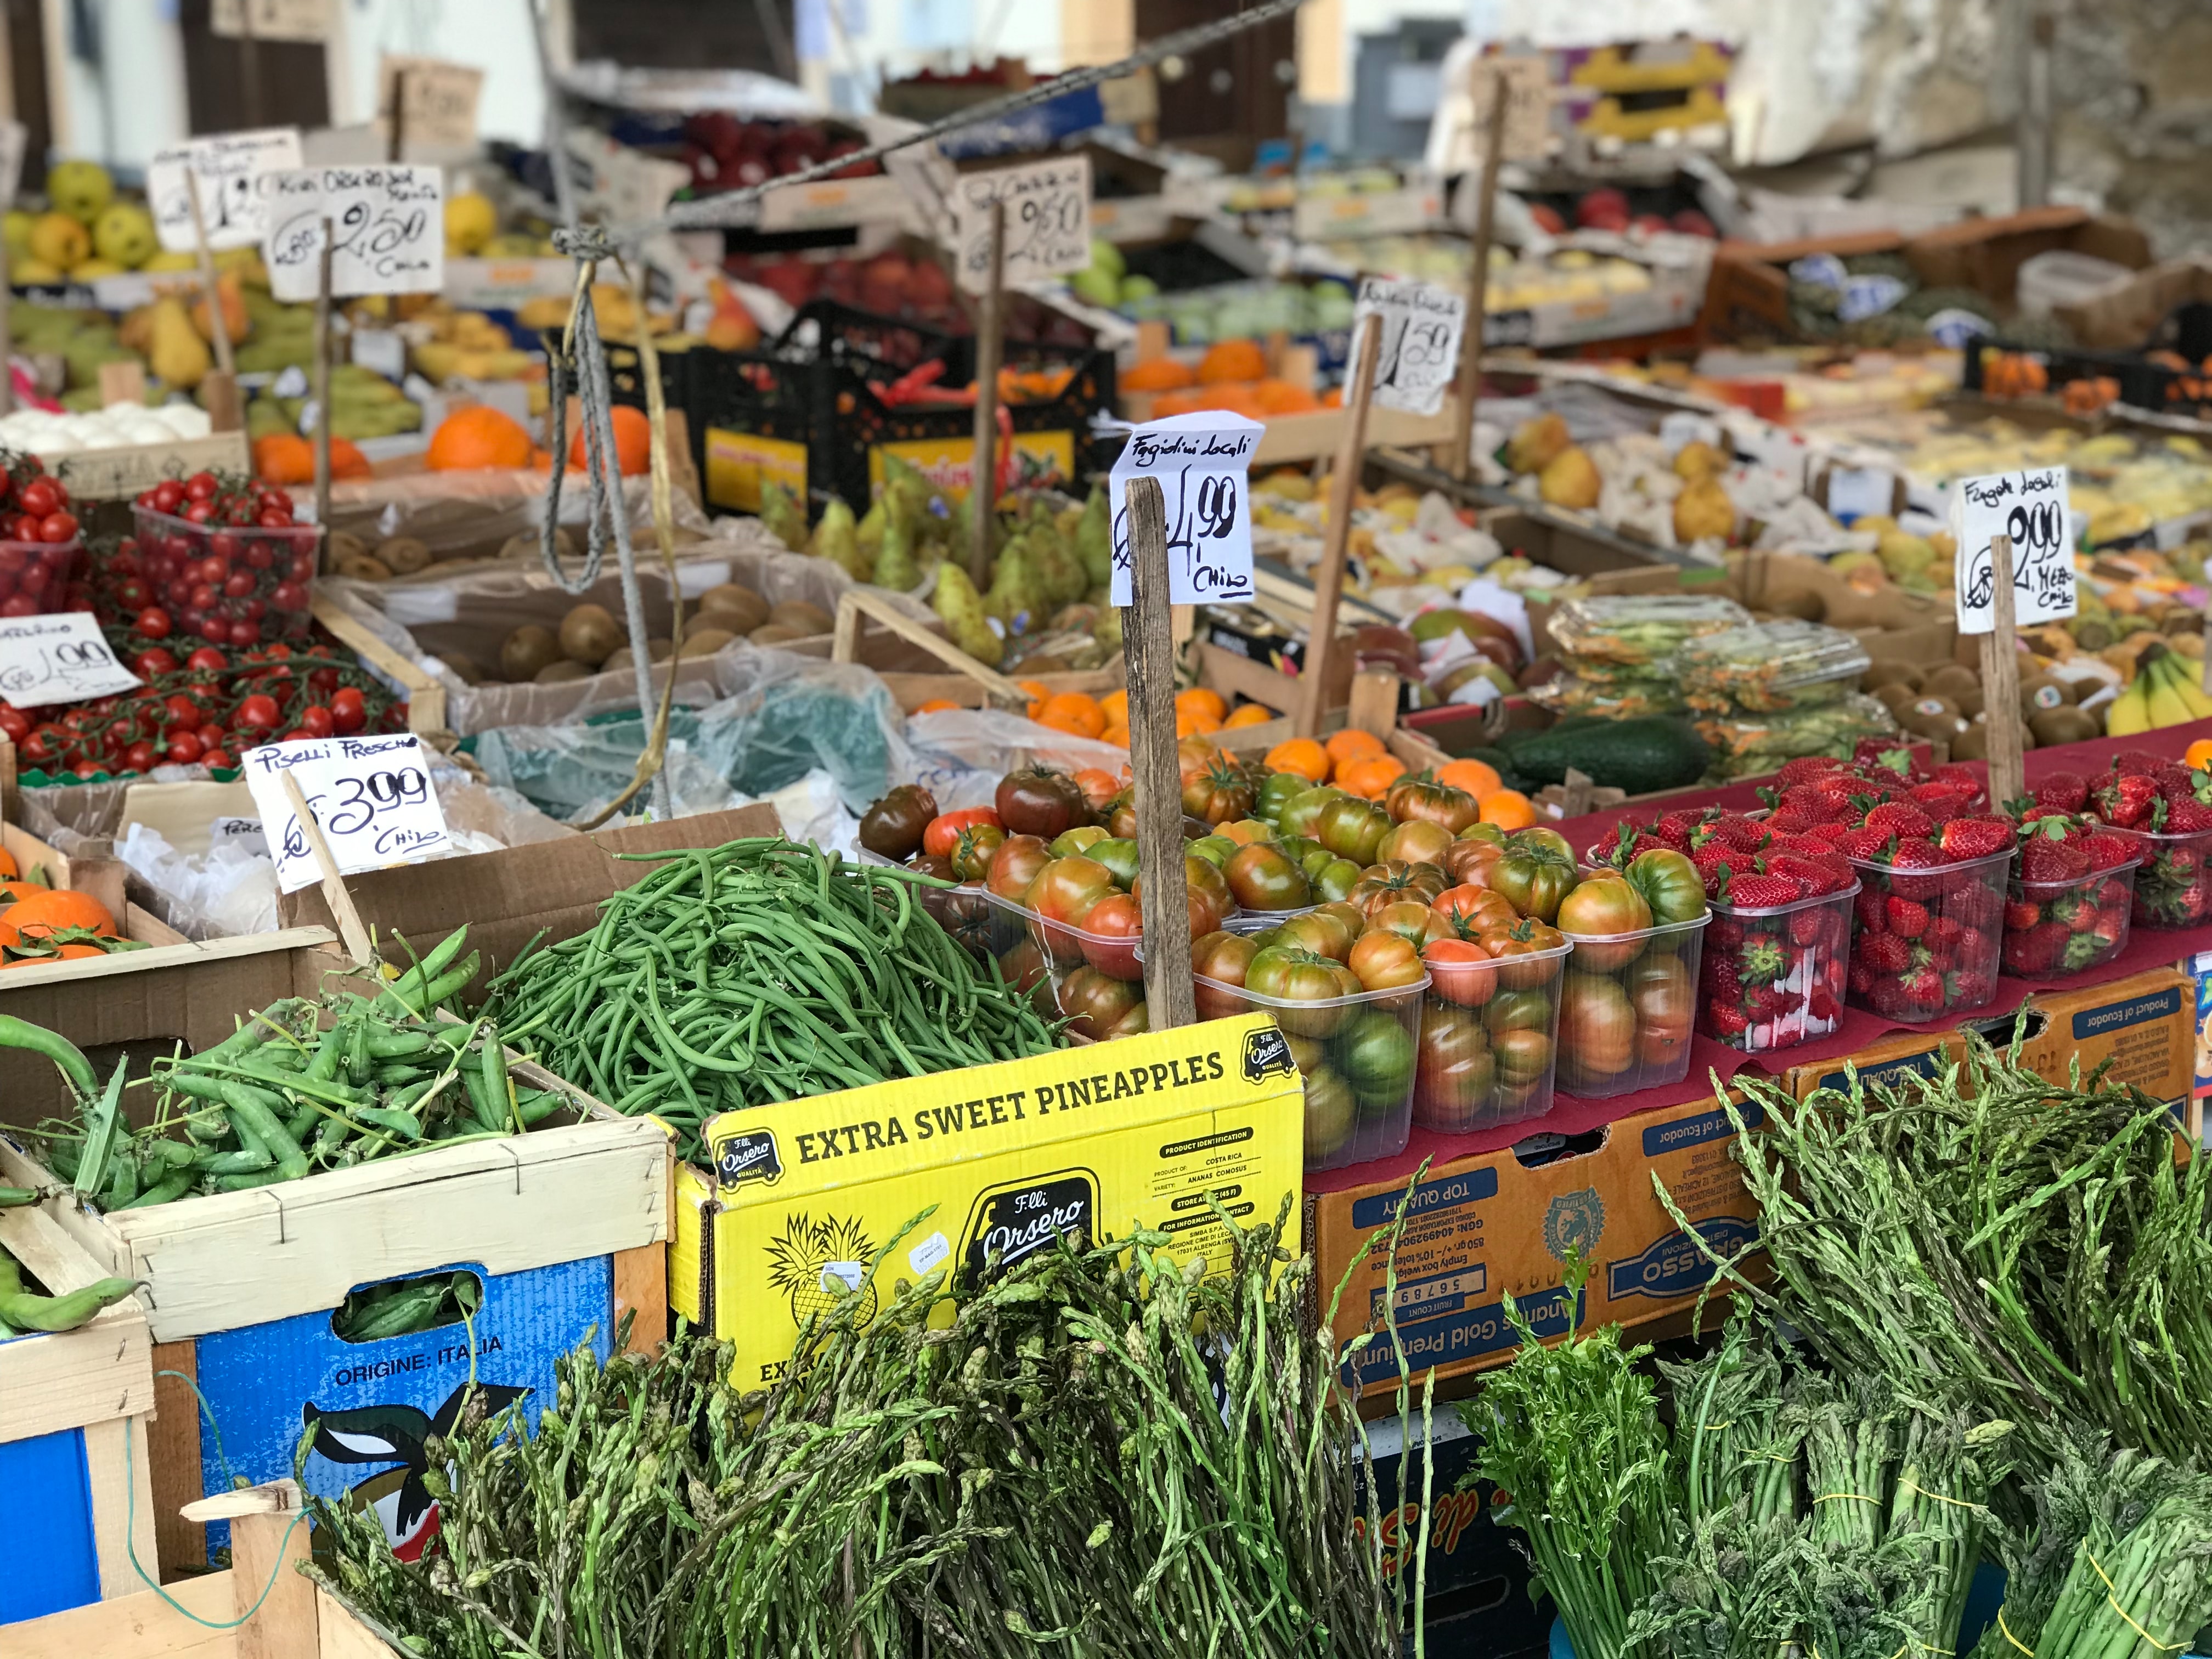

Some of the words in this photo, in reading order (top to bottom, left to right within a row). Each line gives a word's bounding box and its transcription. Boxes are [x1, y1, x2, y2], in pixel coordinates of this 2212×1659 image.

[2125, 1007, 2134, 1020] of
[2136, 997, 2168, 1017] Product
[2087, 1011, 2123, 1028] Ecuador
[1251, 1040, 1283, 1064] Orsero
[795, 1116, 909, 1164] EXTRA
[915, 1091, 1026, 1141] SWEET
[1035, 1052, 1224, 1115] PINEAPPLES
[1659, 1124, 1700, 1143] Ecuador
[1702, 1121, 1713, 1135] of
[1165, 1143, 1197, 1155] PRODUCT
[1197, 1131, 1248, 1148] IDENTIFICATION
[722, 1142, 770, 1172] Orsero
[1154, 1168, 1178, 1177] PRODUCT
[1206, 1156, 1226, 1165] COSTA
[1228, 1152, 1243, 1161] RICA
[1188, 1173, 1213, 1184] ANANAS
[1216, 1165, 1247, 1177] COMOSUS
[1443, 1181, 1470, 1201] TOP
[1177, 1197, 1198, 1209] STORE
[1177, 1214, 1221, 1228] INFORMATION
[1456, 1219, 1483, 1233] GGN:
[983, 1200, 1085, 1261] Orsero
[1189, 1229, 1208, 1238] SIMBA
[1168, 1240, 1194, 1251] REGIONE
[1177, 1247, 1193, 1256] 17031
[1193, 1240, 1221, 1252] ALBENGA
[1467, 1237, 1484, 1249] 850
[1197, 1249, 1213, 1257] ITALY
[1416, 1249, 1435, 1262] 10%
[1421, 1261, 1438, 1273] box
[1427, 1285, 1435, 1297] 7
[1440, 1282, 1448, 1294] 6
[1452, 1279, 1460, 1291] 5
[1401, 1291, 1409, 1304] 9
[1414, 1289, 1421, 1300] 8
[1408, 1304, 1432, 1318] COUNT
[1433, 1300, 1452, 1311] FRUIT
[1451, 1319, 1497, 1350] Gold
[335, 1353, 432, 1386] ORIGINE:
[1431, 1488, 1479, 1555] di
